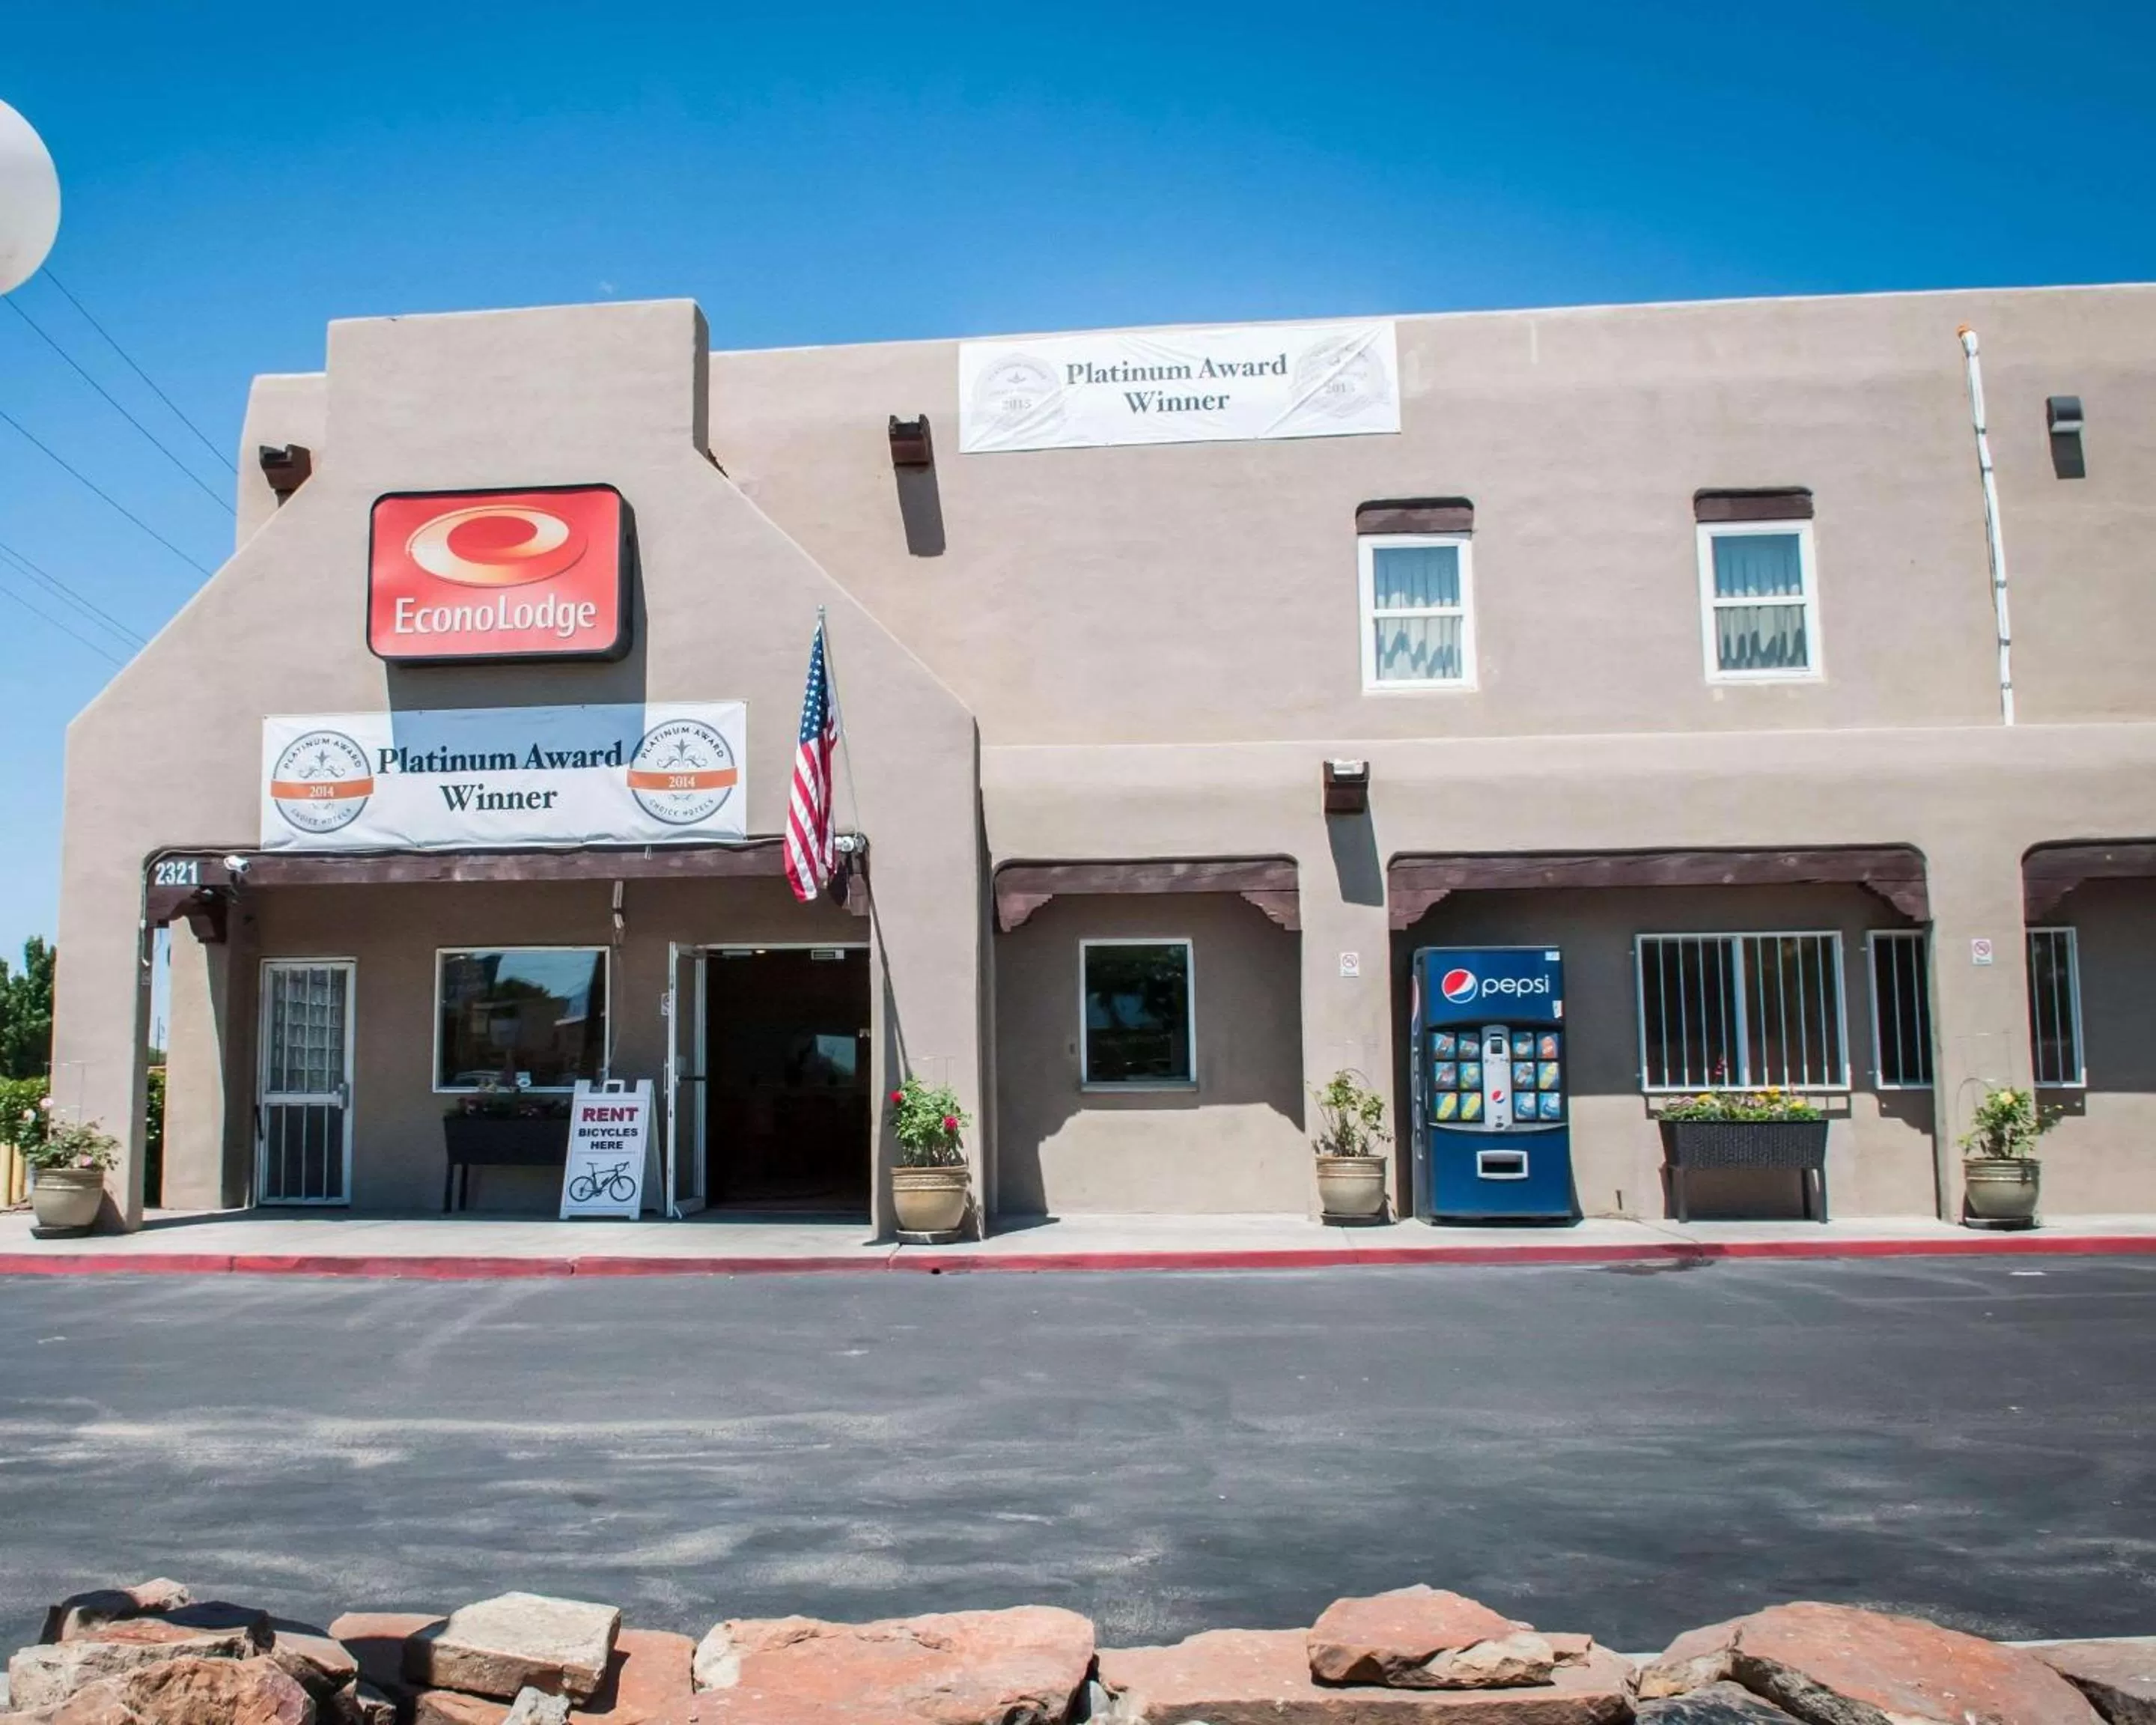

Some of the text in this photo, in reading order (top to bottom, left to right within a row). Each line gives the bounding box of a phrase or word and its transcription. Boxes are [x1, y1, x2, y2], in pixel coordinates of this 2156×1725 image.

[1066, 360, 1192, 385] Platinum
[1199, 353, 1288, 379] Award
[1124, 390, 1230, 414] Winner
[640, 726, 725, 759] PLATINUM AWARD
[377, 740, 623, 774] Platinum Award
[309, 785, 335, 798] 2014
[669, 774, 696, 788] 2014
[439, 783, 558, 812] Winner
[155, 860, 198, 886] 2321
[1481, 974, 1550, 998] pepsi
[582, 1107, 639, 1122] RENT
[578, 1128, 638, 1137] BICYCLES
[591, 1141, 624, 1149] HERE
